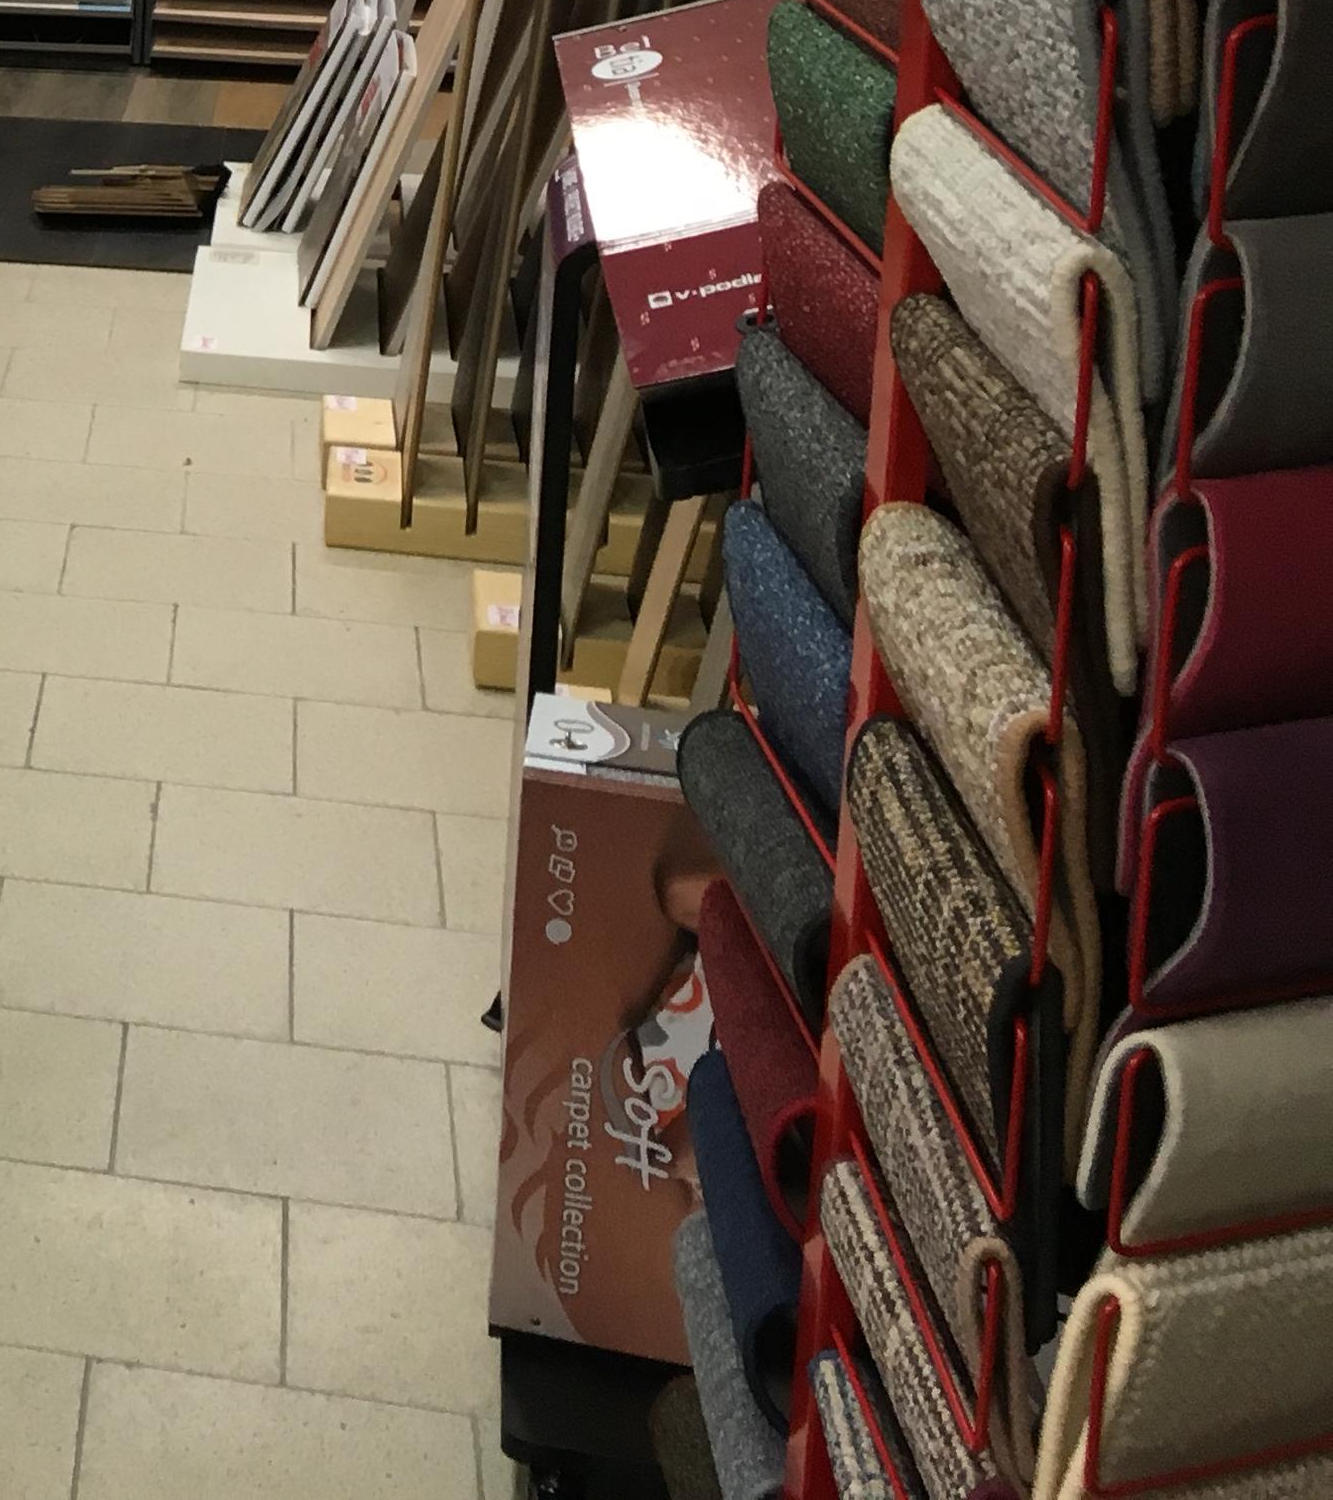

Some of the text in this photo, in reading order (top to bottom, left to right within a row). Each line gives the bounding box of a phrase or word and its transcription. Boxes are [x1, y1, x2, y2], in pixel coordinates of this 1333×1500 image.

[560, 1057, 593, 1295] carpet collection
[604, 1057, 683, 1191] Soft
